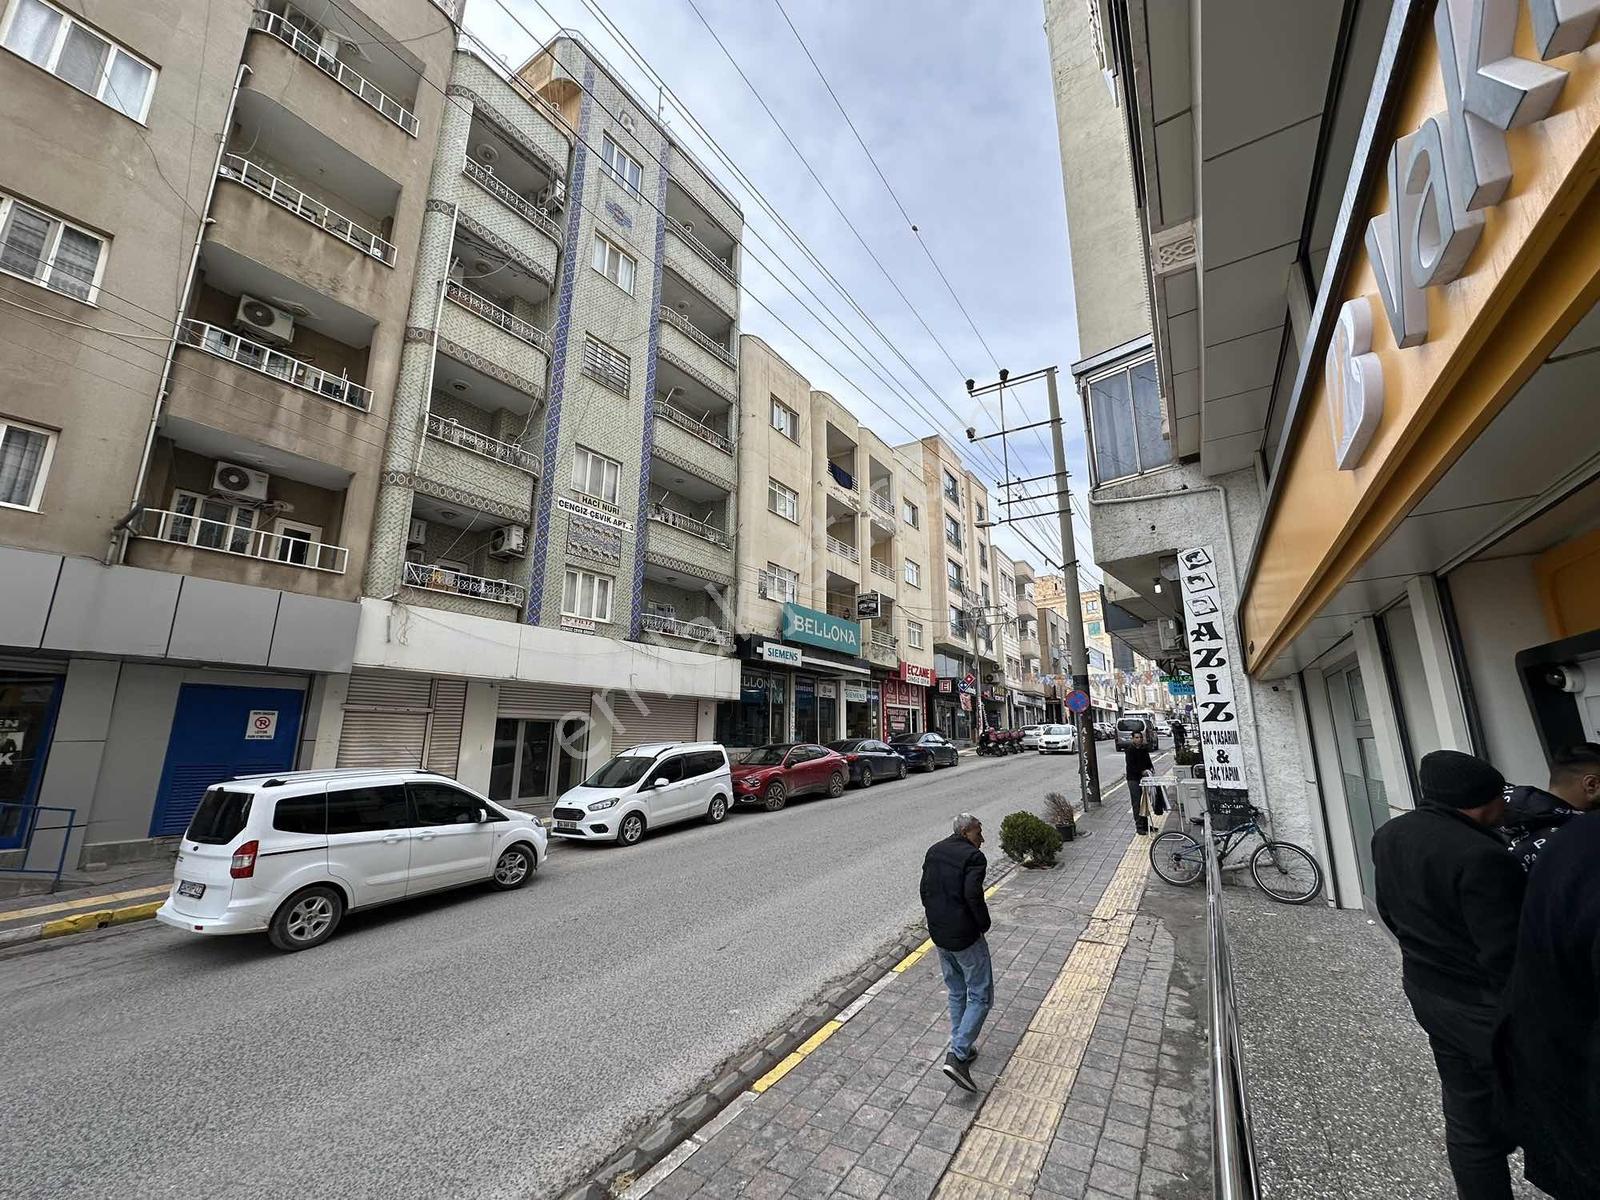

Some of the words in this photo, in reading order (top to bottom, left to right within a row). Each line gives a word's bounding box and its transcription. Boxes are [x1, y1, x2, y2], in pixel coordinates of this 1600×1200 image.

[582, 496, 600, 508] HACI
[793, 615, 857, 646] BELLONA
[767, 647, 798, 661] SIEMENS
[907, 664, 930, 678] ECZANE
[742, 675, 777, 690] LLONA
[1216, 749, 1230, 764] &
